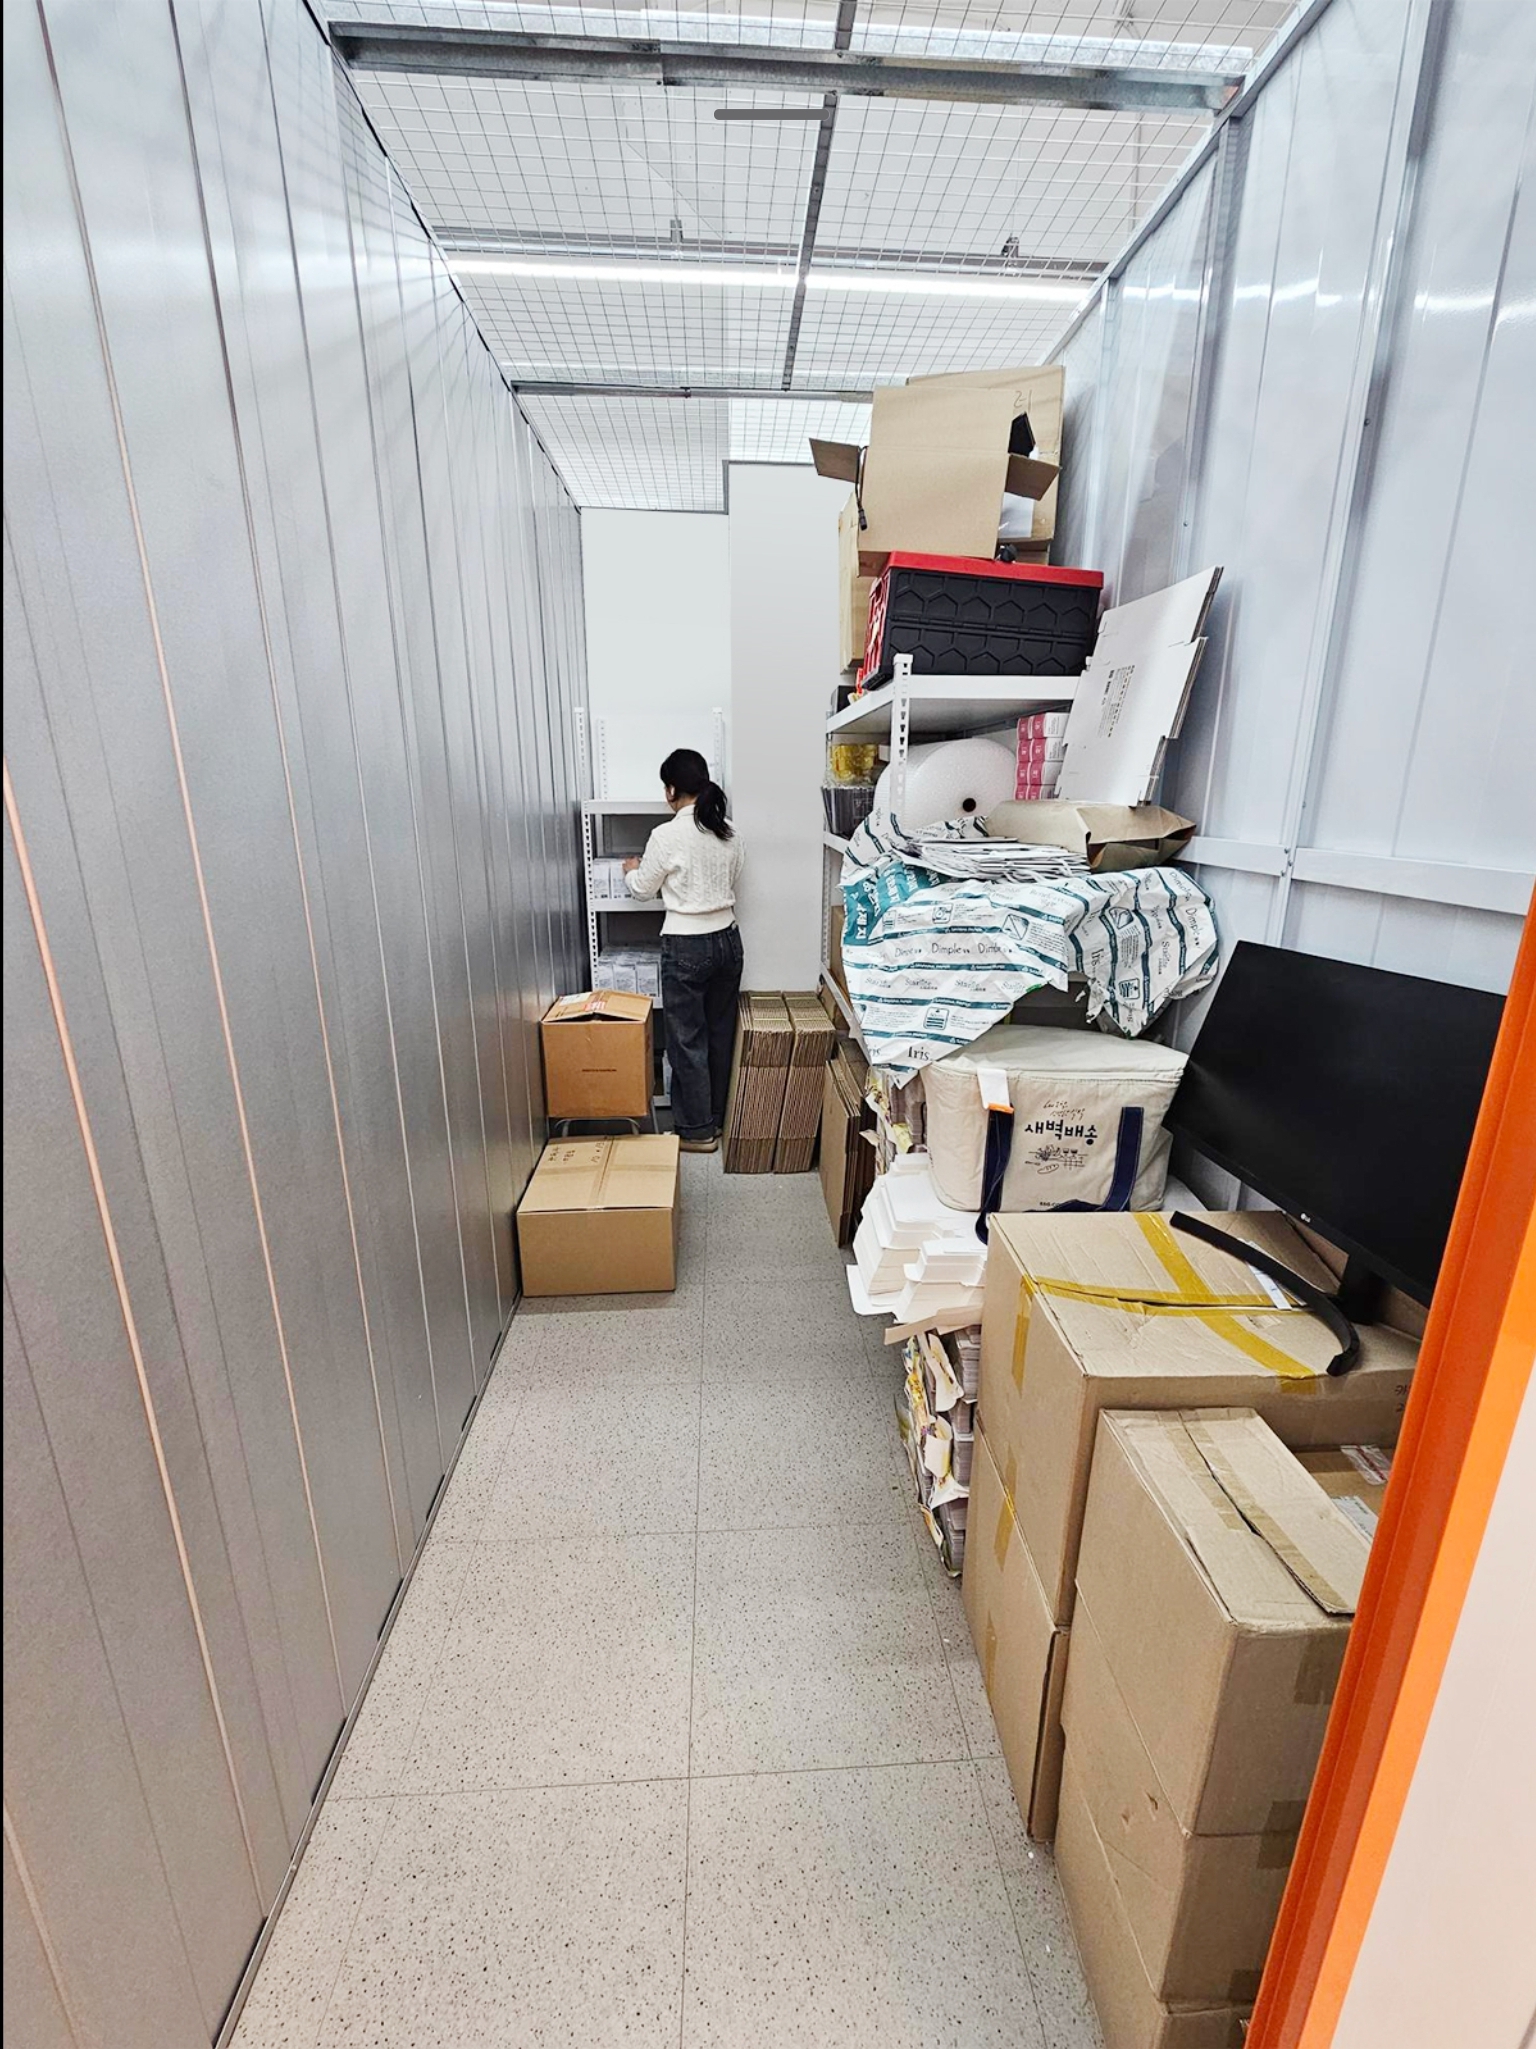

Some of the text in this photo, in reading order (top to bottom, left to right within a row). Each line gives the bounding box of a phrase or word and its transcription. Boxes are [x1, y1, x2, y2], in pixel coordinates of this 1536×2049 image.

[931, 942, 962, 955] Dimple
[907, 1045, 930, 1061] Iris
[1024, 1119, 1098, 1145] 새벽배송
